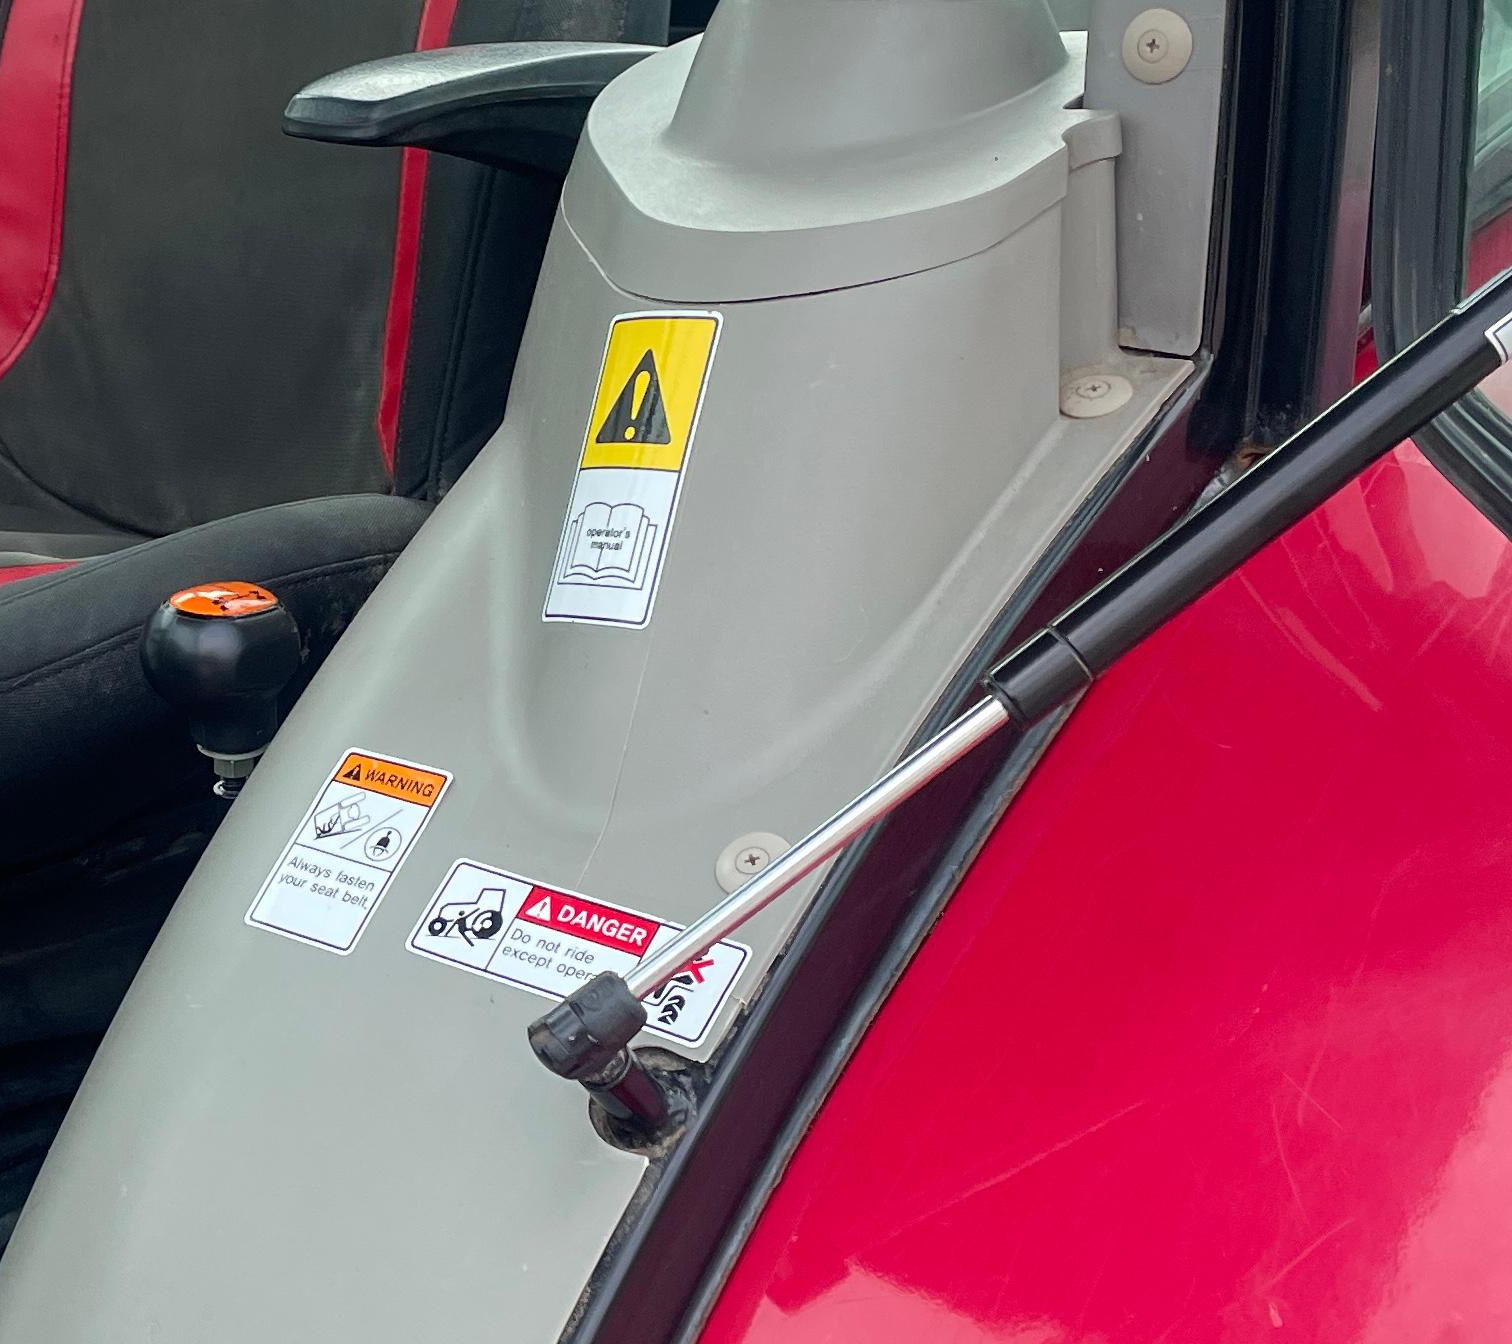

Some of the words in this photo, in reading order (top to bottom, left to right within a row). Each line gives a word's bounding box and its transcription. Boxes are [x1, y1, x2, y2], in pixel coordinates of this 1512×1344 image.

[366, 768, 435, 798] WARNING
[278, 872, 308, 889] your
[310, 882, 338, 899] seat
[341, 889, 369, 910] belt.
[287, 856, 332, 879] Always
[335, 870, 376, 892] fasten
[556, 904, 649, 947] DANGER
[502, 946, 552, 968] except
[510, 928, 531, 944] Do
[536, 938, 561, 953] not
[565, 946, 595, 964] ride
